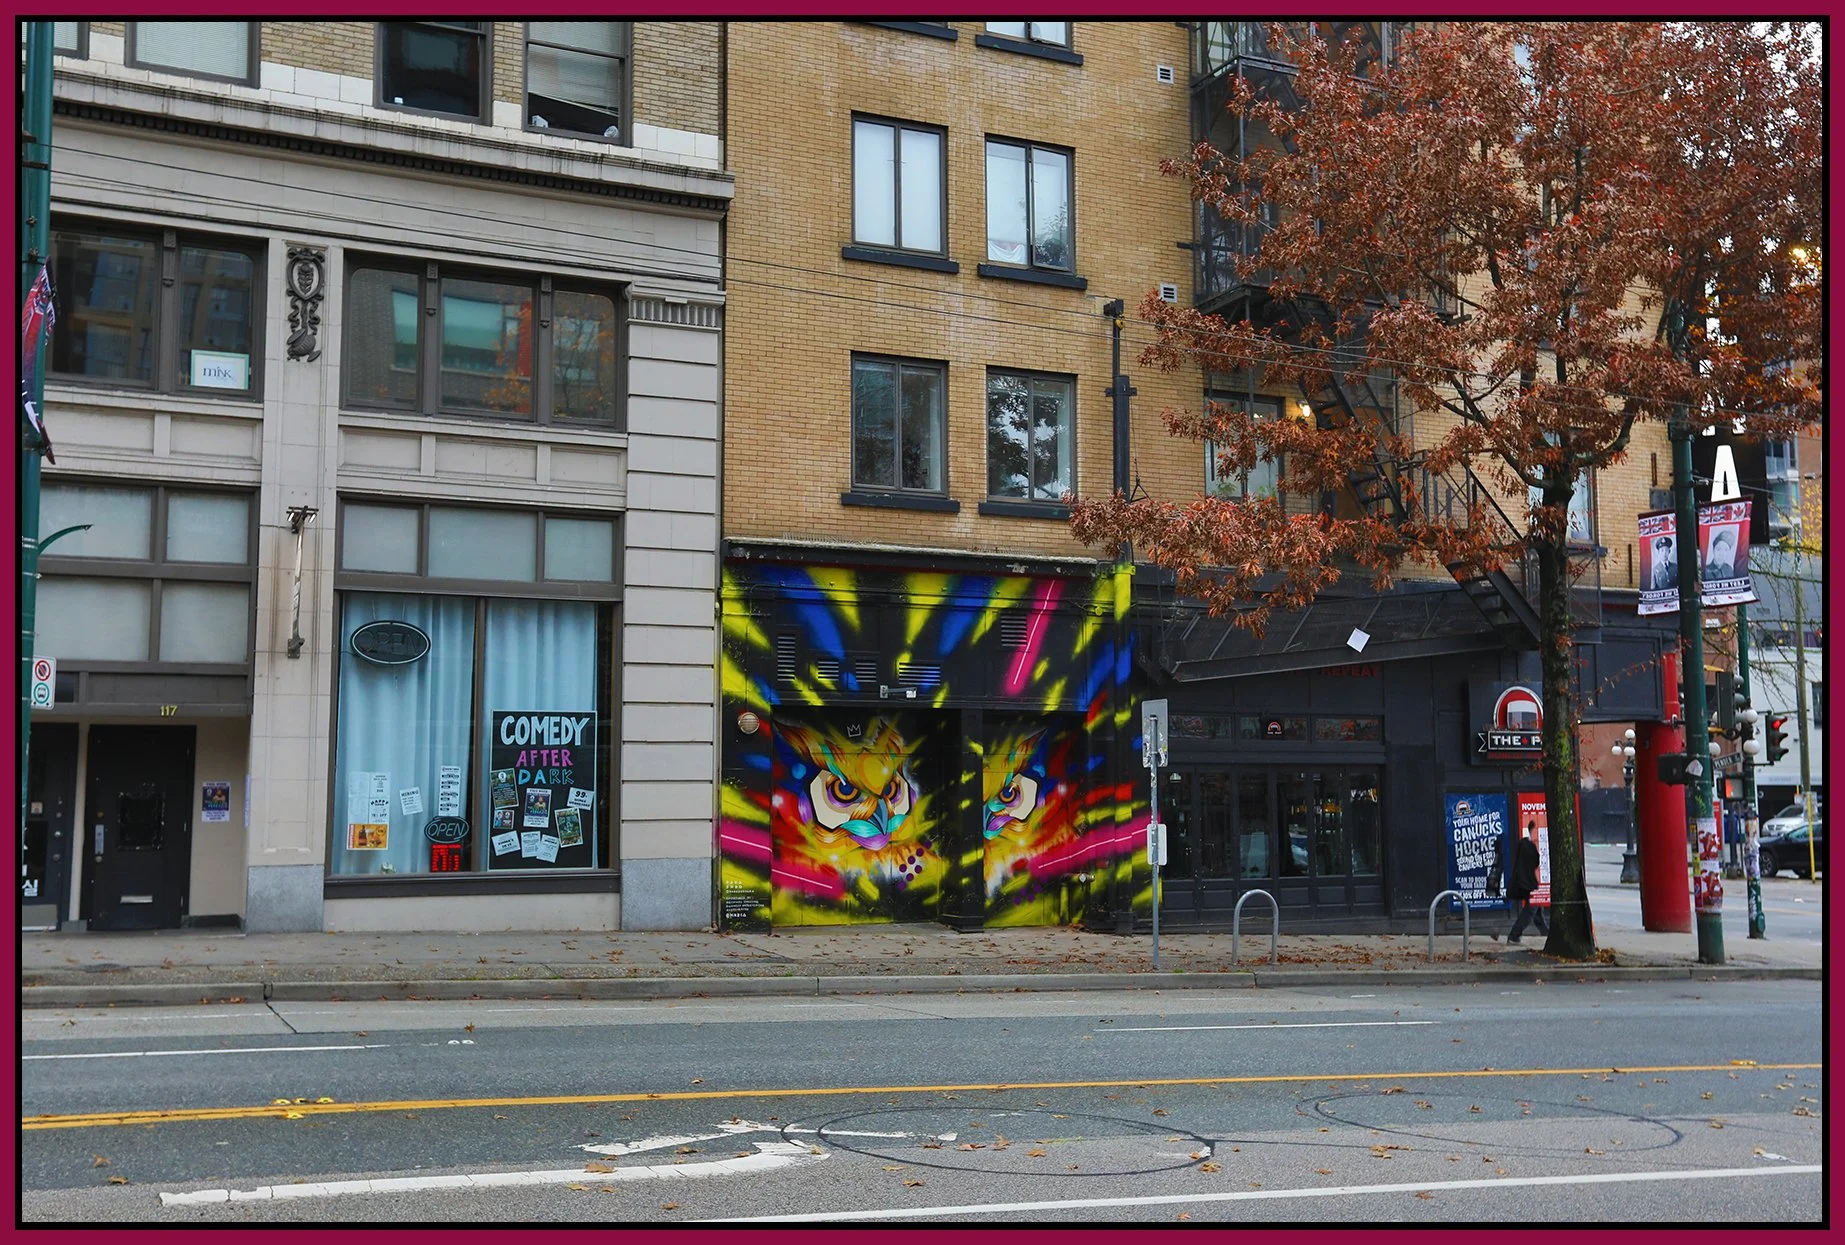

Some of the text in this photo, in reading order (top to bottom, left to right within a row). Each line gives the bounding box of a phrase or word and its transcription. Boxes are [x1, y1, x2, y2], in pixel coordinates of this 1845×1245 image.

[160, 705, 177, 716] 117
[500, 715, 591, 746] COMEDY
[1492, 735, 1543, 746] THE P
[516, 749, 573, 768] AFTER
[518, 769, 575, 785] DARK
[1521, 803, 1546, 811] NOVEM
[1452, 811, 1500, 828] YOUR HOME FOR
[428, 822, 465, 837] OPEN
[1453, 821, 1503, 842] CANUCKS
[1455, 836, 1497, 857] HOCKE
